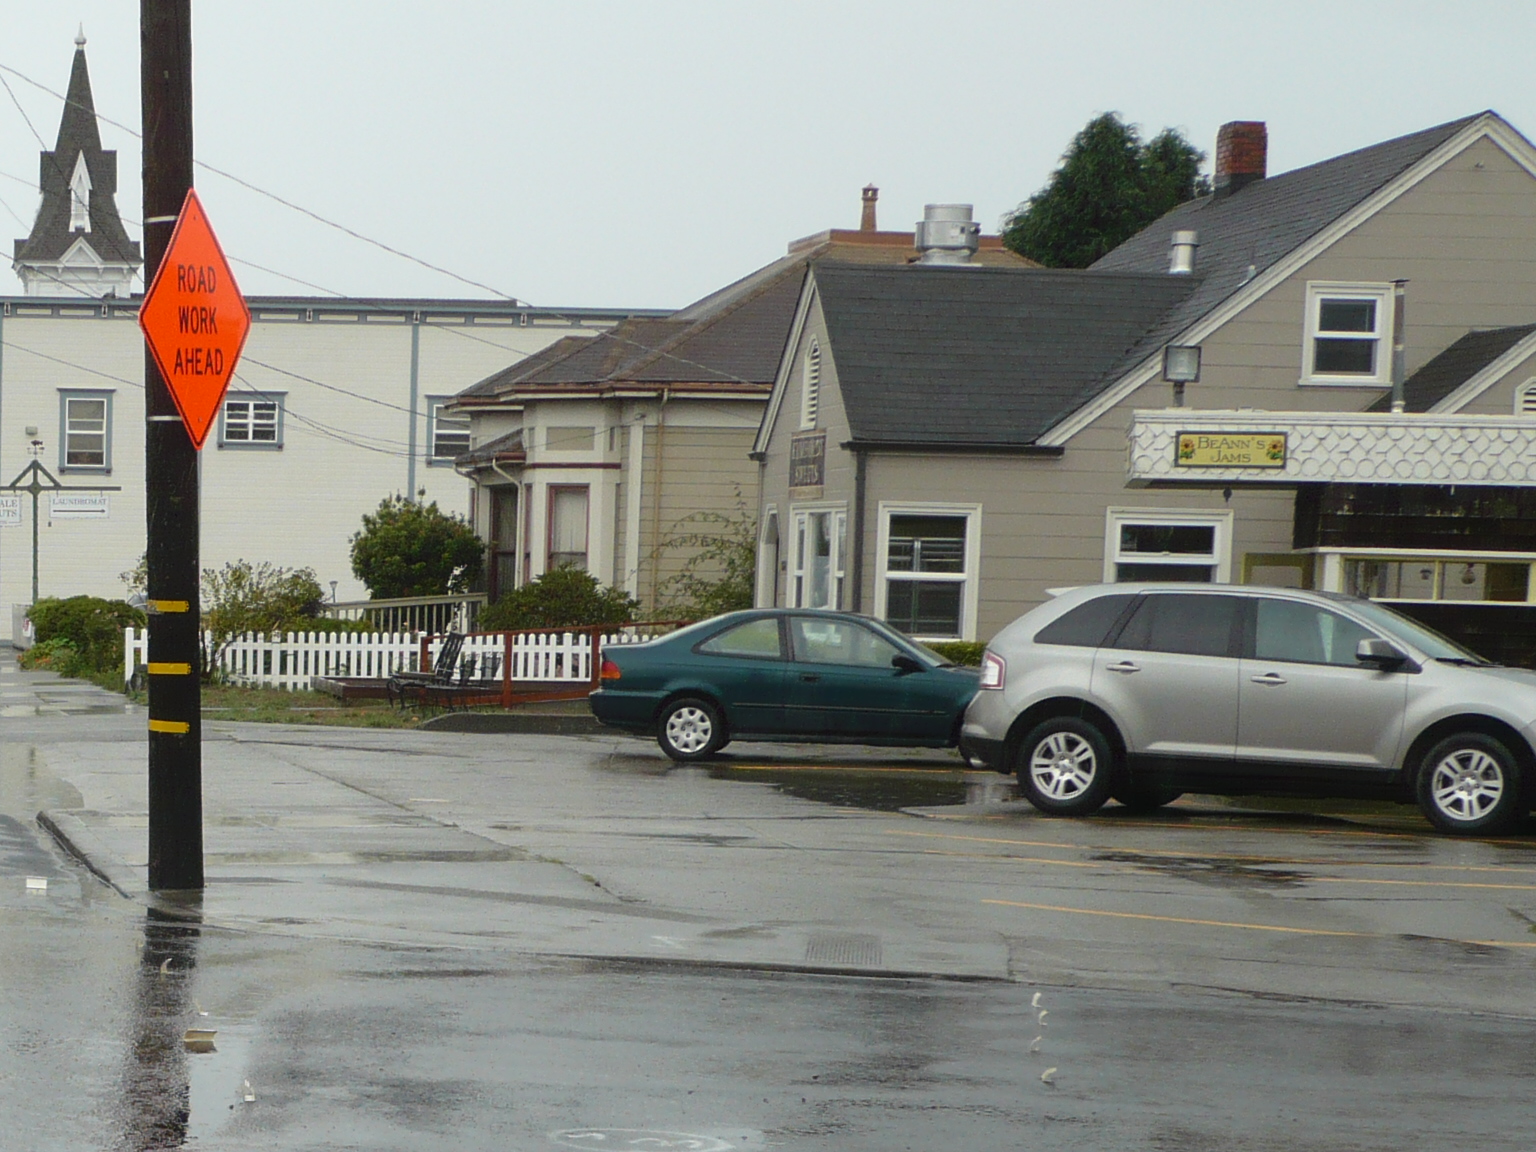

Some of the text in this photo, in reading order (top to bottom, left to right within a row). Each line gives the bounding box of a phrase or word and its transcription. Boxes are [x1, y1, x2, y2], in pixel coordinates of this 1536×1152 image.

[177, 265, 217, 294] ROAD
[178, 306, 218, 335] WORK
[173, 348, 224, 376] AHEAD
[1212, 450, 1252, 463] JAMS
